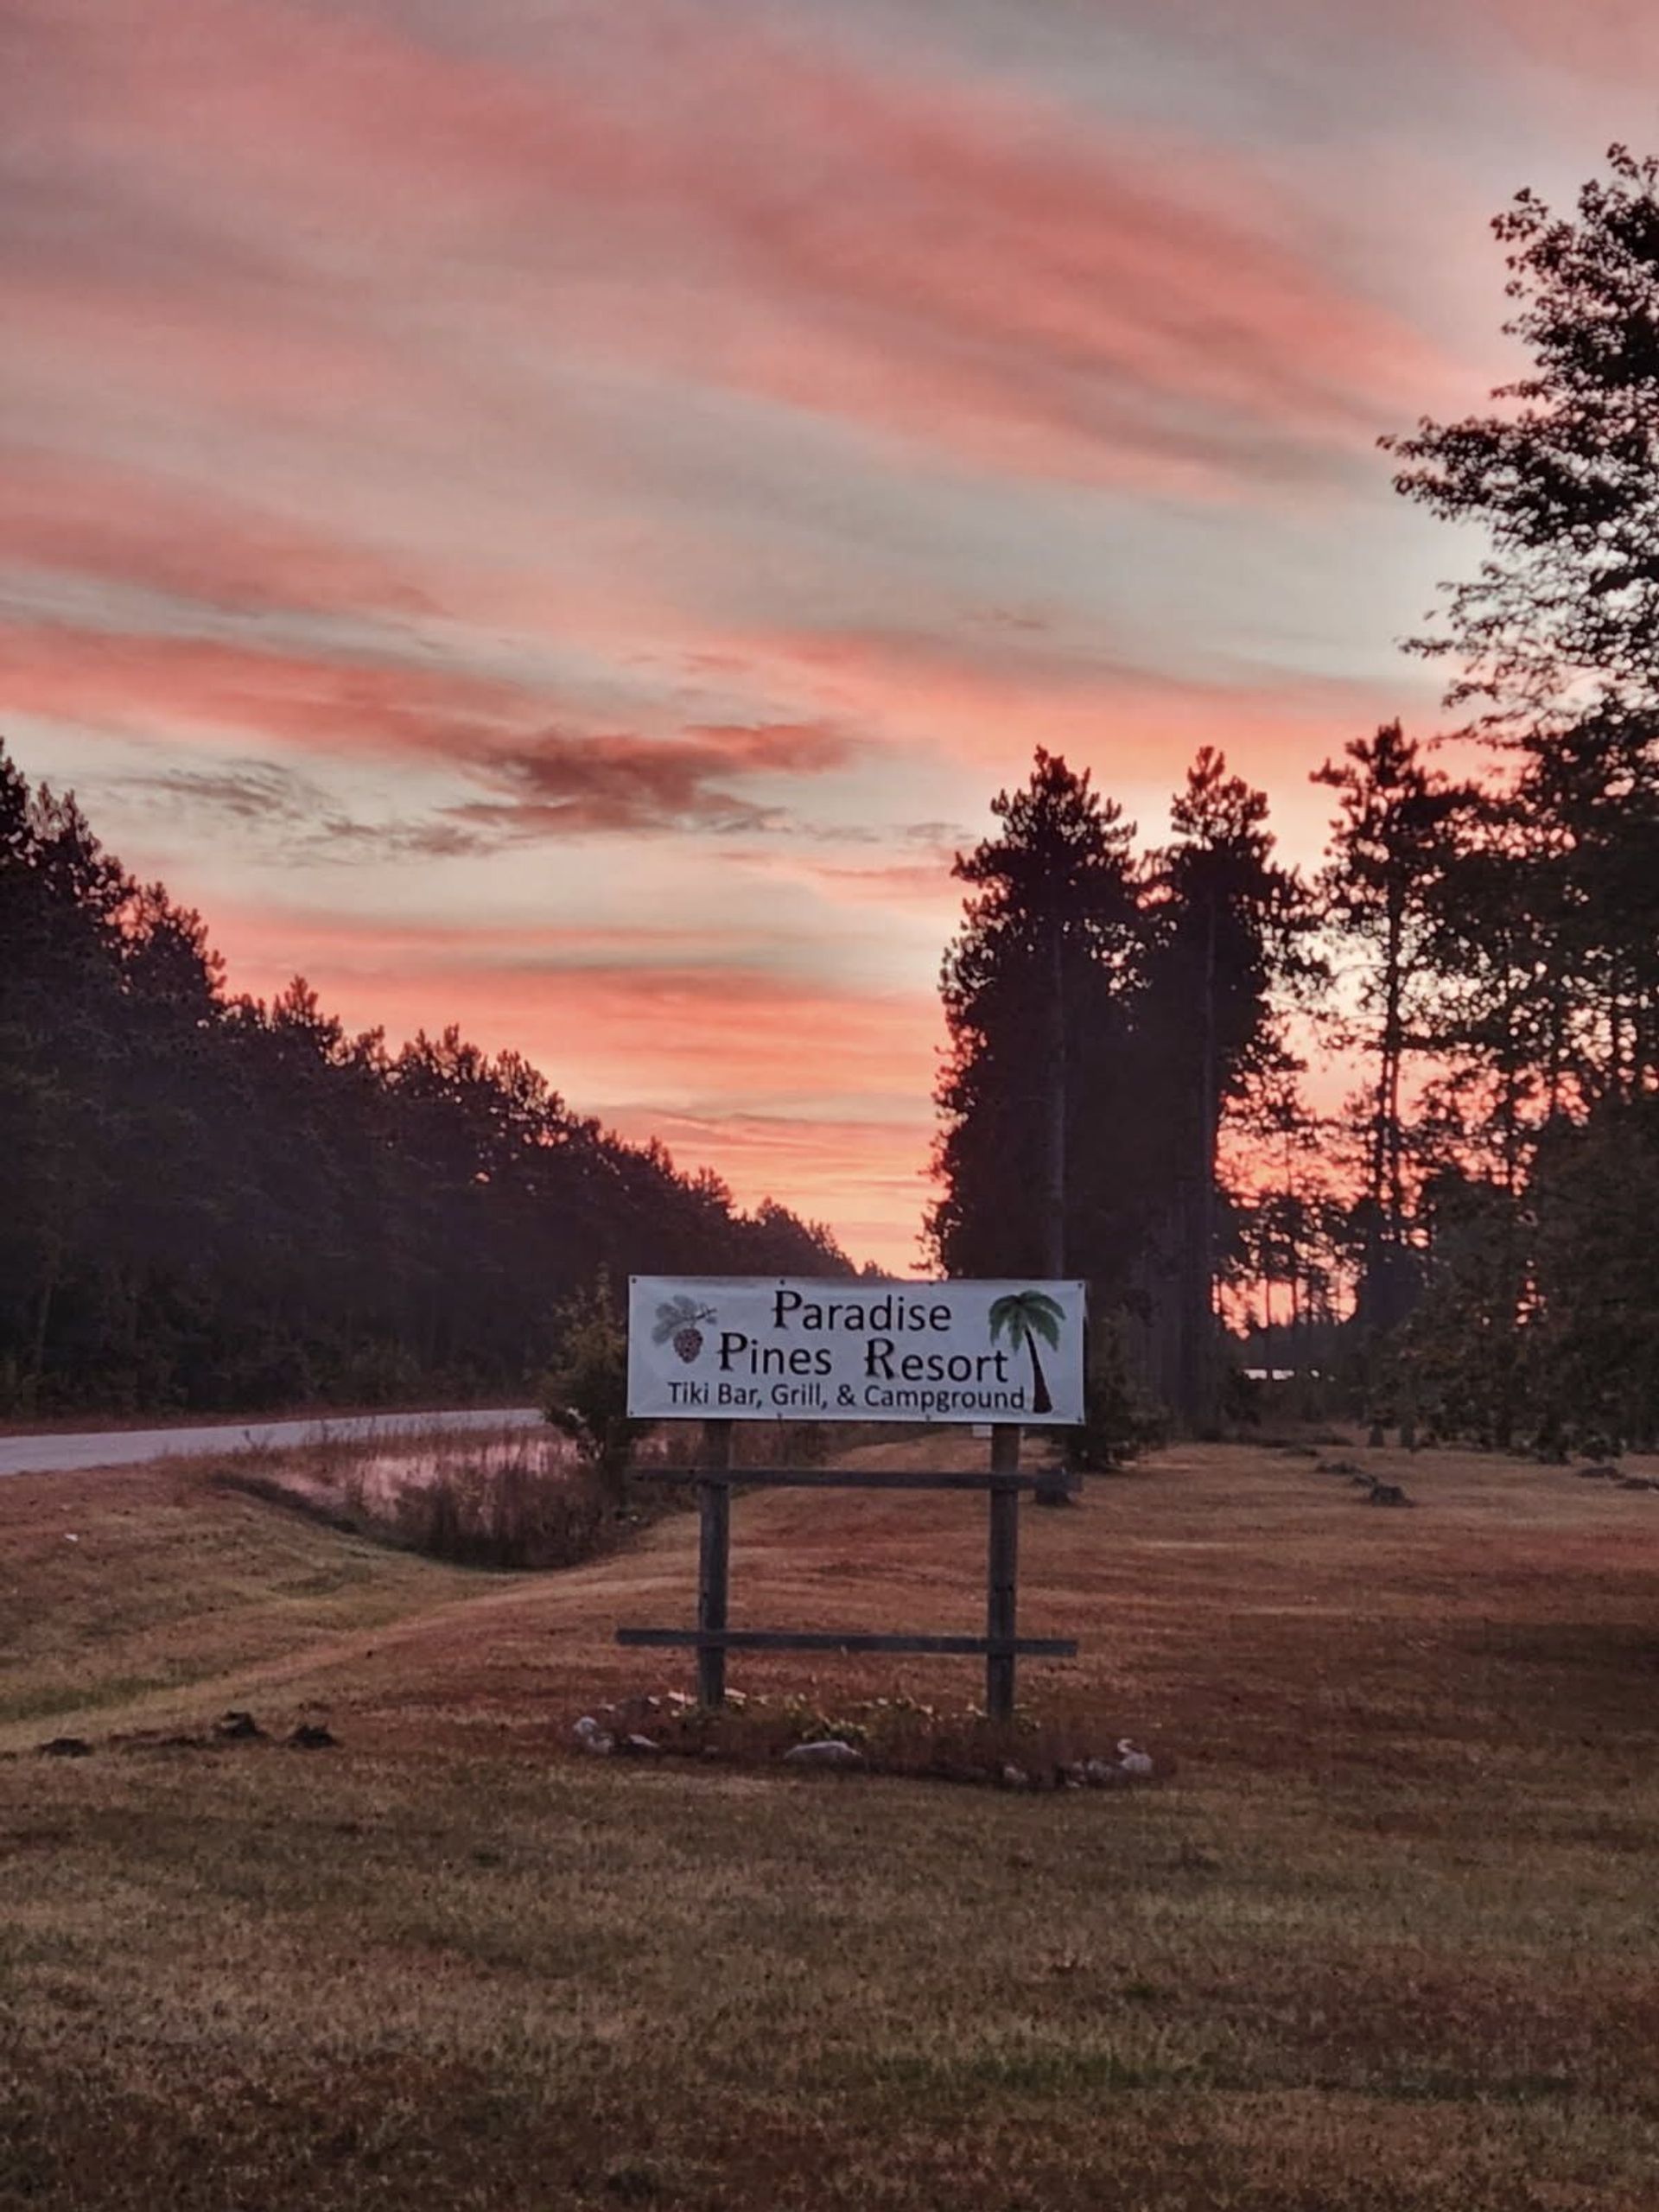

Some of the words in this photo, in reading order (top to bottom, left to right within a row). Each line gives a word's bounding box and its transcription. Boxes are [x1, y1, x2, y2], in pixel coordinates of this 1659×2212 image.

[772, 1290, 952, 1332] Paradise
[717, 1332, 832, 1376] Pines
[864, 1337, 1008, 1382] Resort
[667, 1382, 709, 1406] Tiki
[718, 1383, 762, 1409] Bar,
[772, 1383, 827, 1410] Grill,
[836, 1387, 856, 1408] &
[864, 1387, 1026, 1414] Campground
